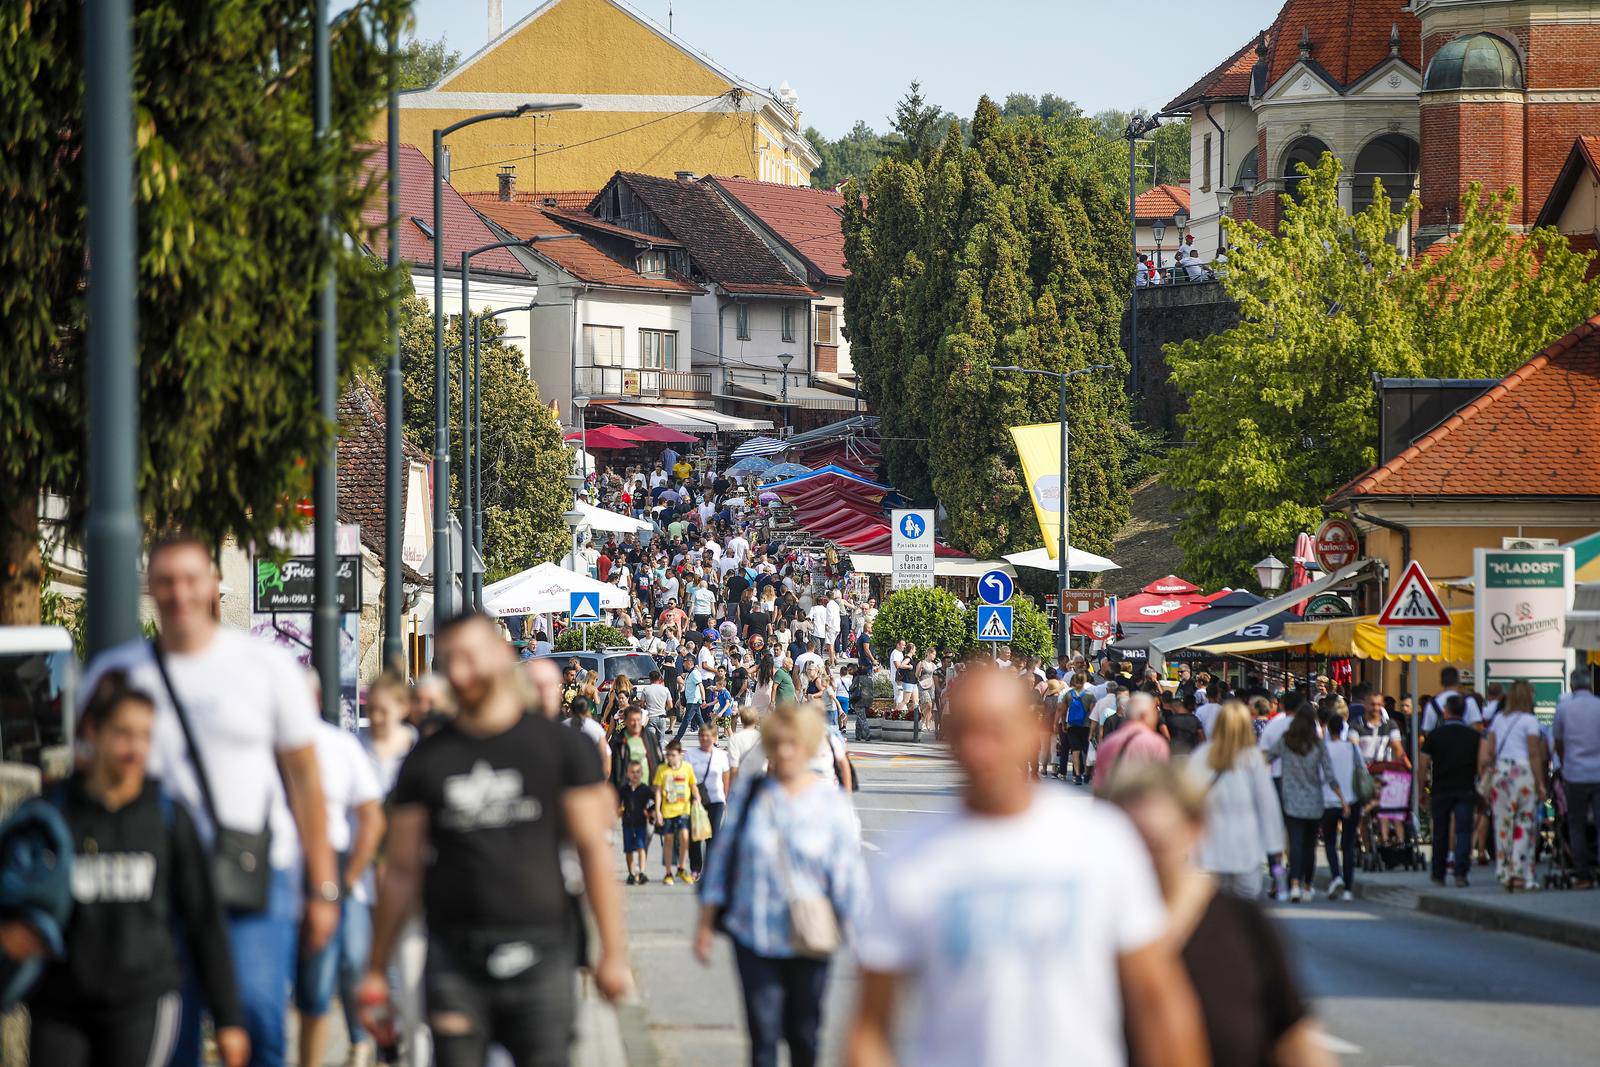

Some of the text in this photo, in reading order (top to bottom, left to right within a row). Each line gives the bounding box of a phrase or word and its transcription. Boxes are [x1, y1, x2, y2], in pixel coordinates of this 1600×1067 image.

[904, 554, 923, 562] Osim
[498, 606, 531, 615] SLADOLED
[1490, 612, 1561, 646] Staropramen
[1398, 635, 1429, 648] 50 m
